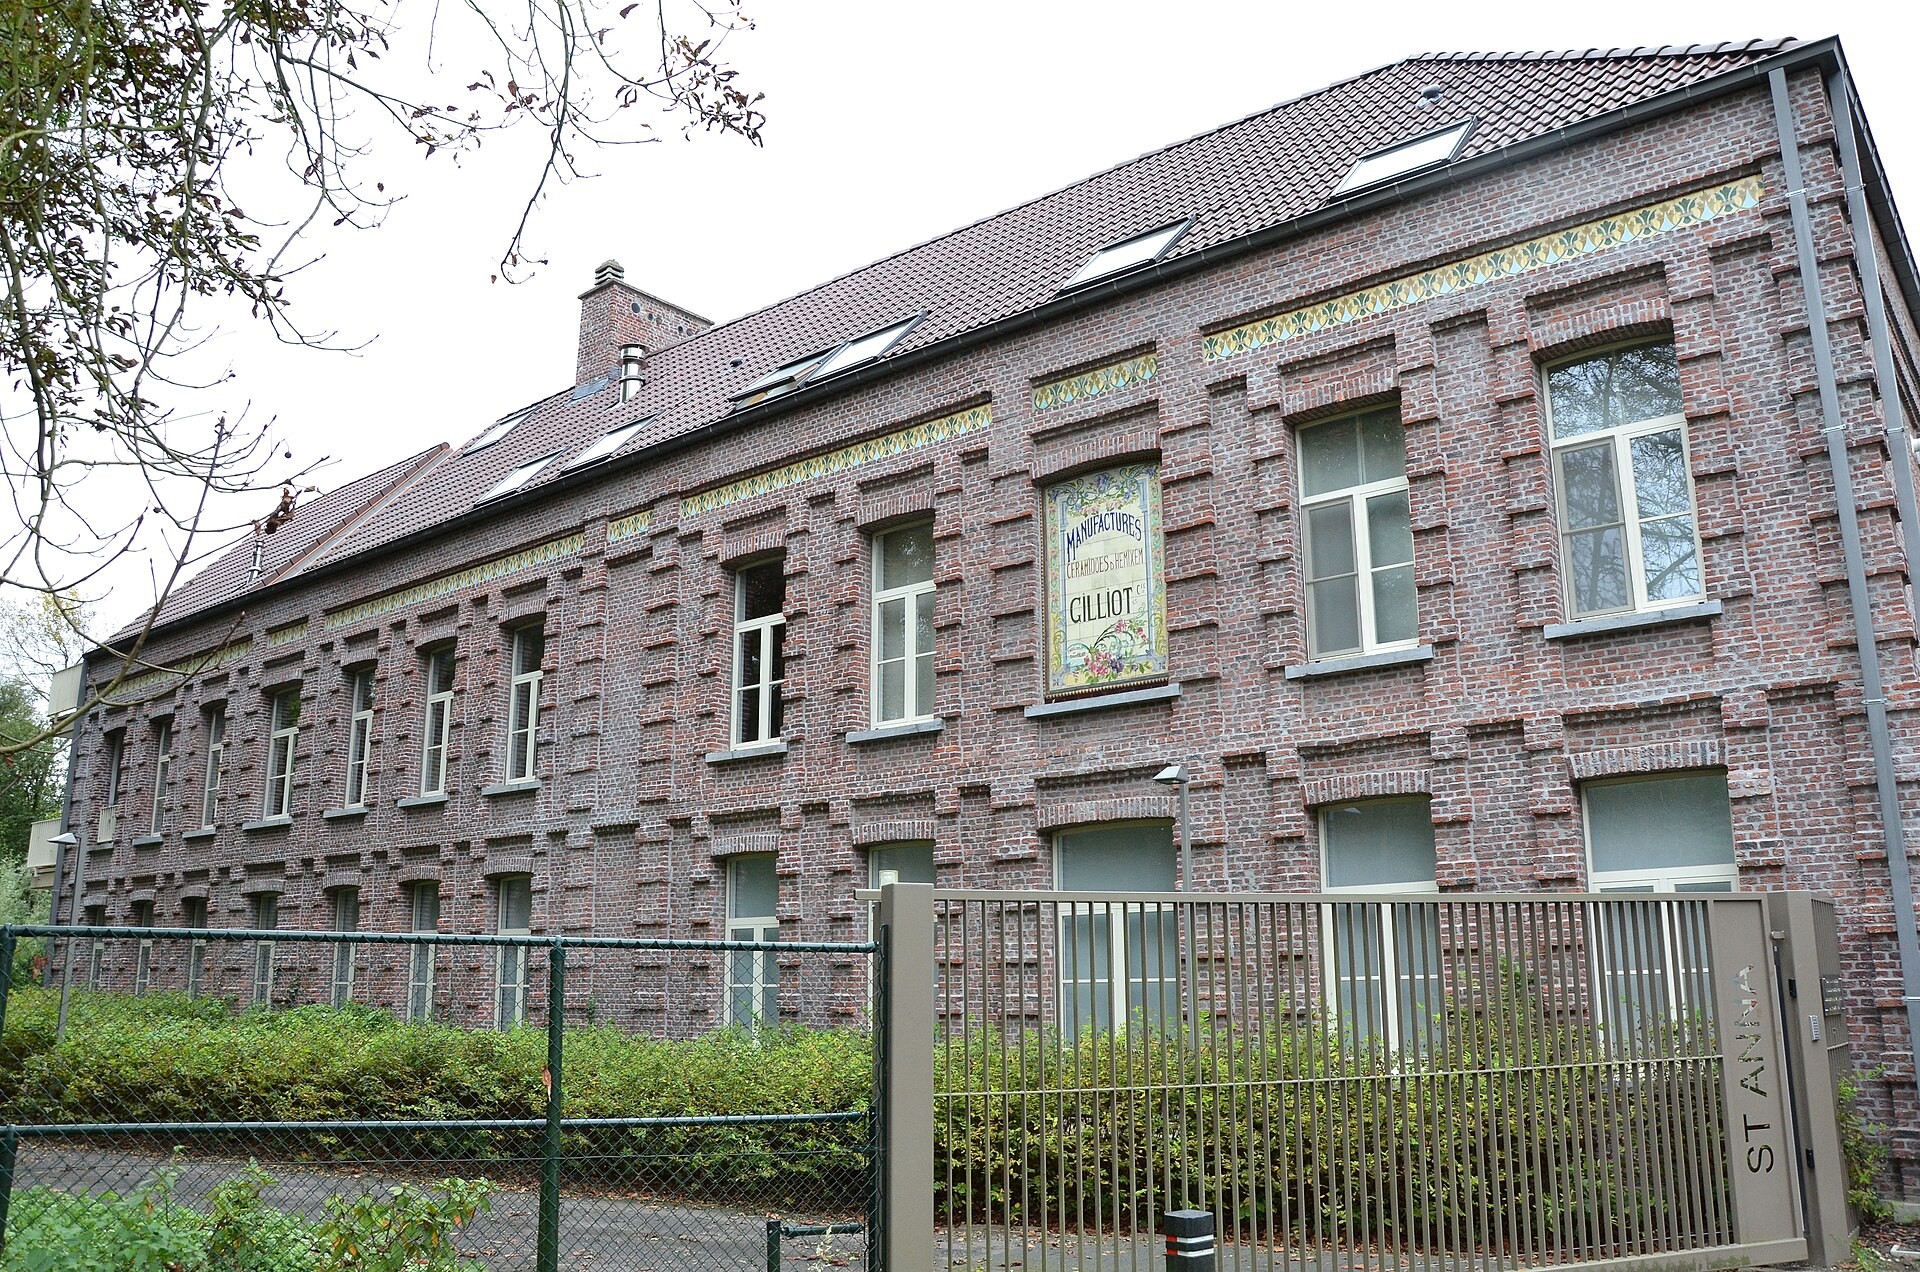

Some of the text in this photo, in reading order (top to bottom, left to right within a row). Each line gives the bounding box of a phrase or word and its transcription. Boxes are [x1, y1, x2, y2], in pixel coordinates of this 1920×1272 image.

[1066, 511, 1142, 562] MANUFACTURES
[1731, 963, 1774, 1173] ST ANNA
